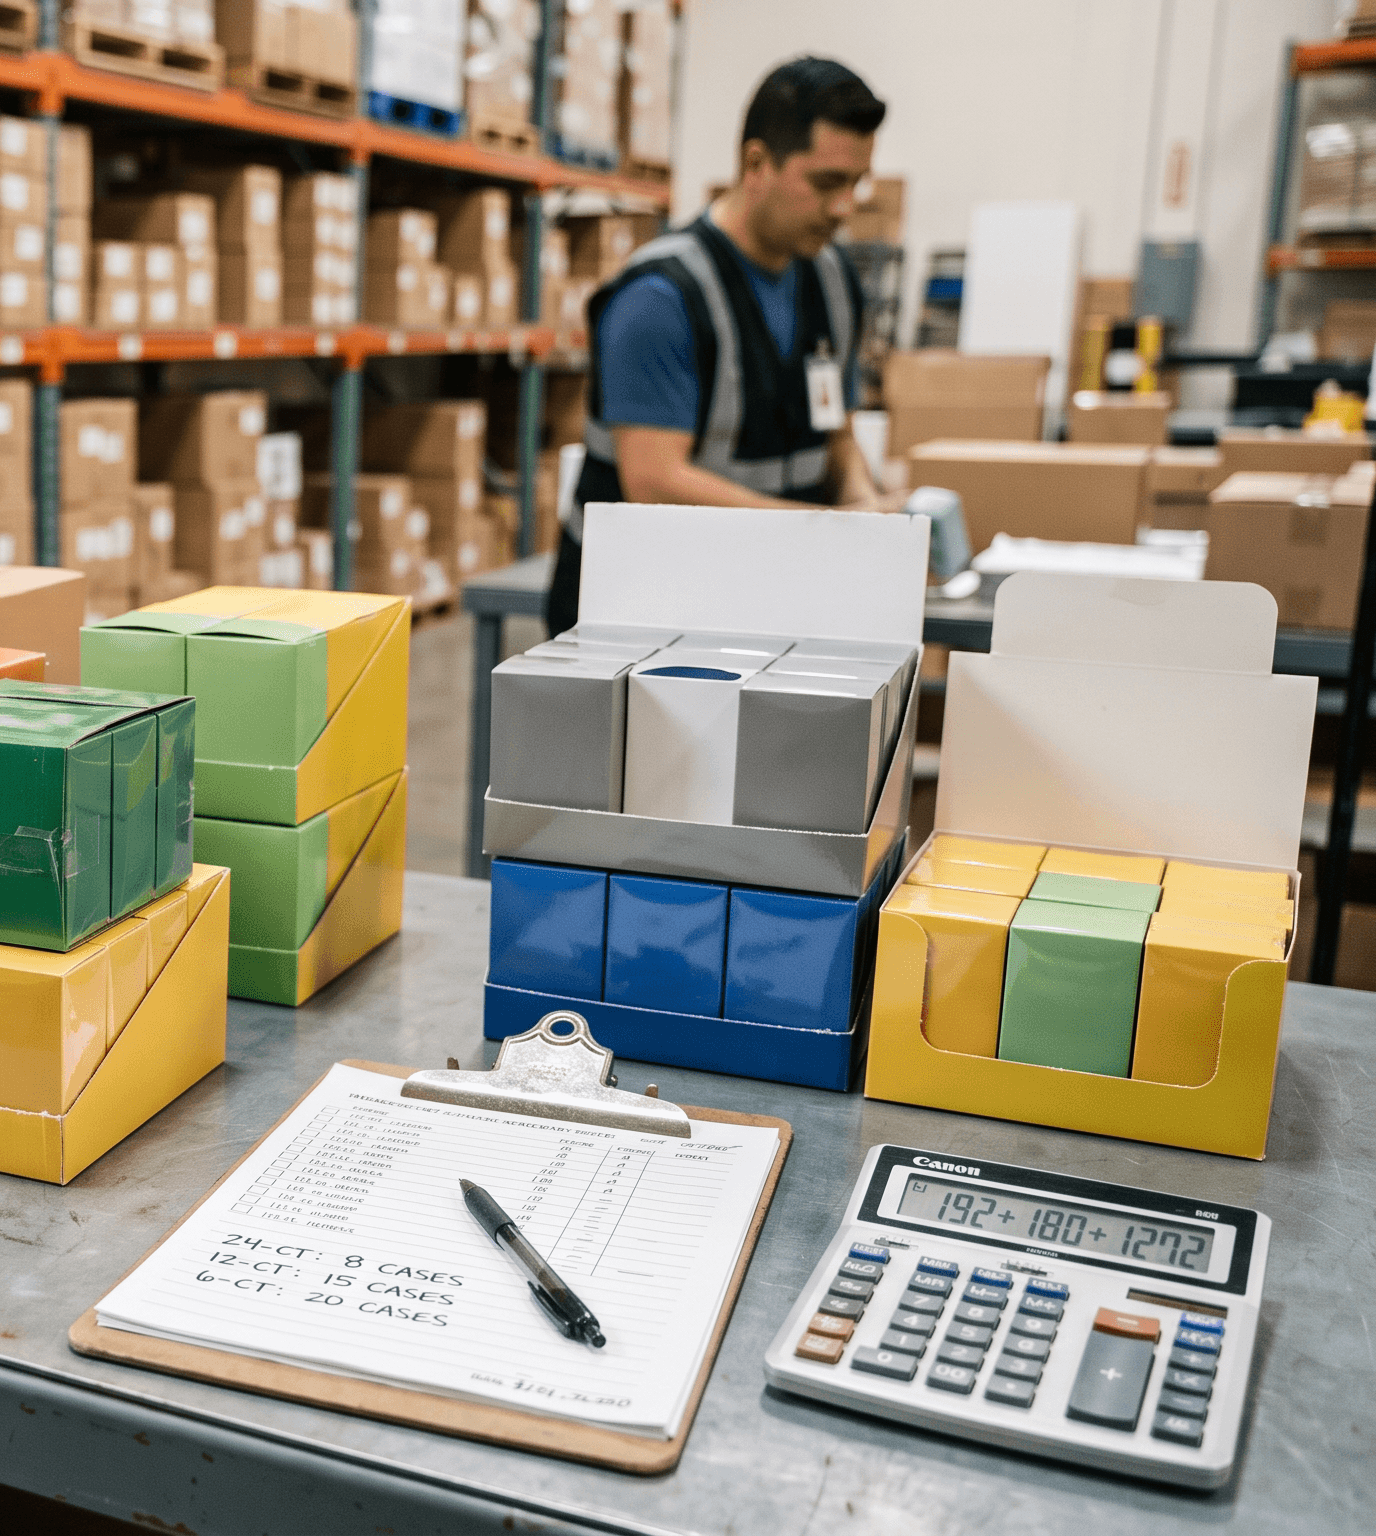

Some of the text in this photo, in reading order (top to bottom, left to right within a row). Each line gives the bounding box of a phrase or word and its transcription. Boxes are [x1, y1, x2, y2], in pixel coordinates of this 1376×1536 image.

[912, 1156, 981, 1177] Canon
[221, 1233, 465, 1287] 24-CT: 8 CASES
[1120, 1225, 1206, 1271] 1272
[209, 1251, 455, 1306] 12-CT: 15 CASES
[195, 1270, 449, 1327] 6-CT: 20 CASES
[903, 1315, 918, 1326] 4
[877, 1351, 893, 1363] 0
[934, 1365, 966, 1379] 00
